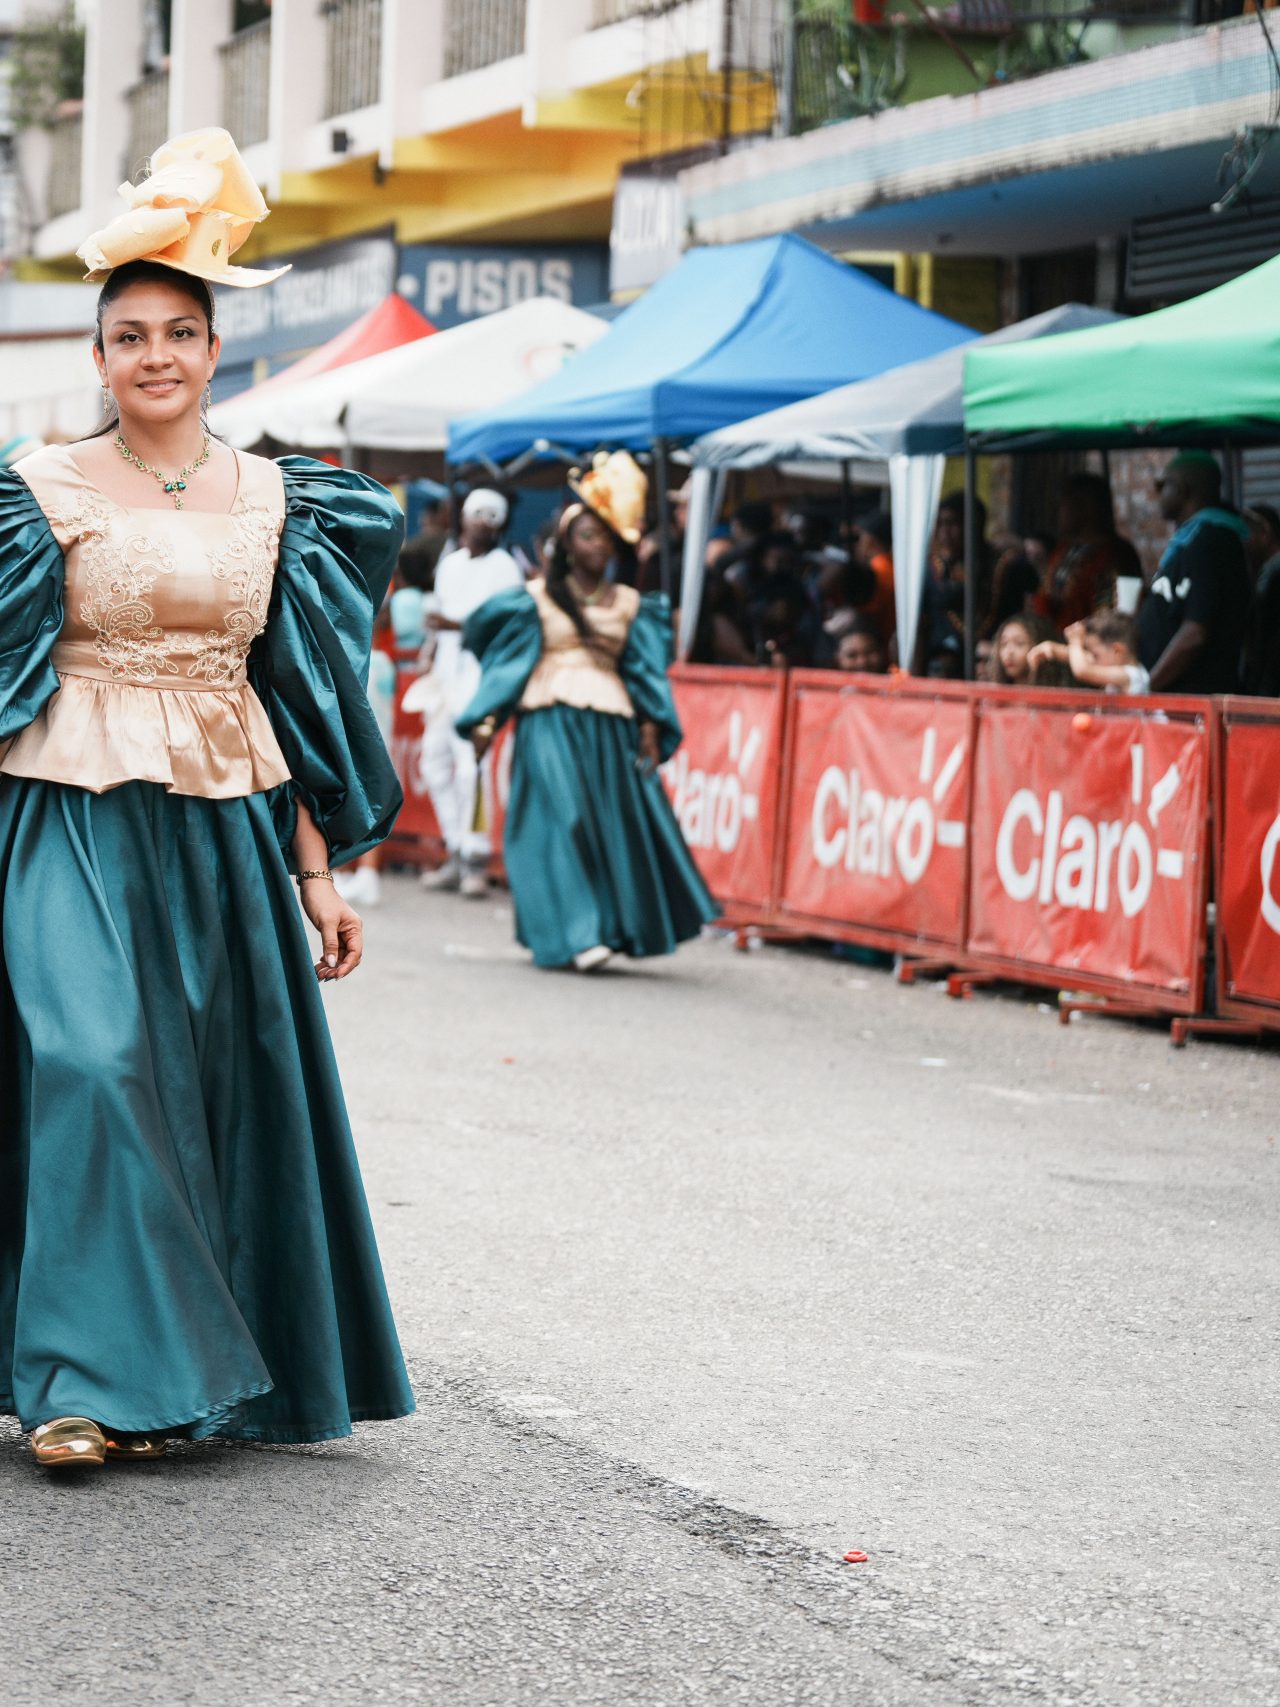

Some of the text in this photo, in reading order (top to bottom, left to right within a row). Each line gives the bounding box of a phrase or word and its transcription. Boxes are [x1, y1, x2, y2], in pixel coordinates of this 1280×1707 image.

[424, 258, 573, 316] PISOS
[657, 749, 743, 853] laro
[811, 765, 934, 884] Claro
[996, 787, 1153, 918] Claro
